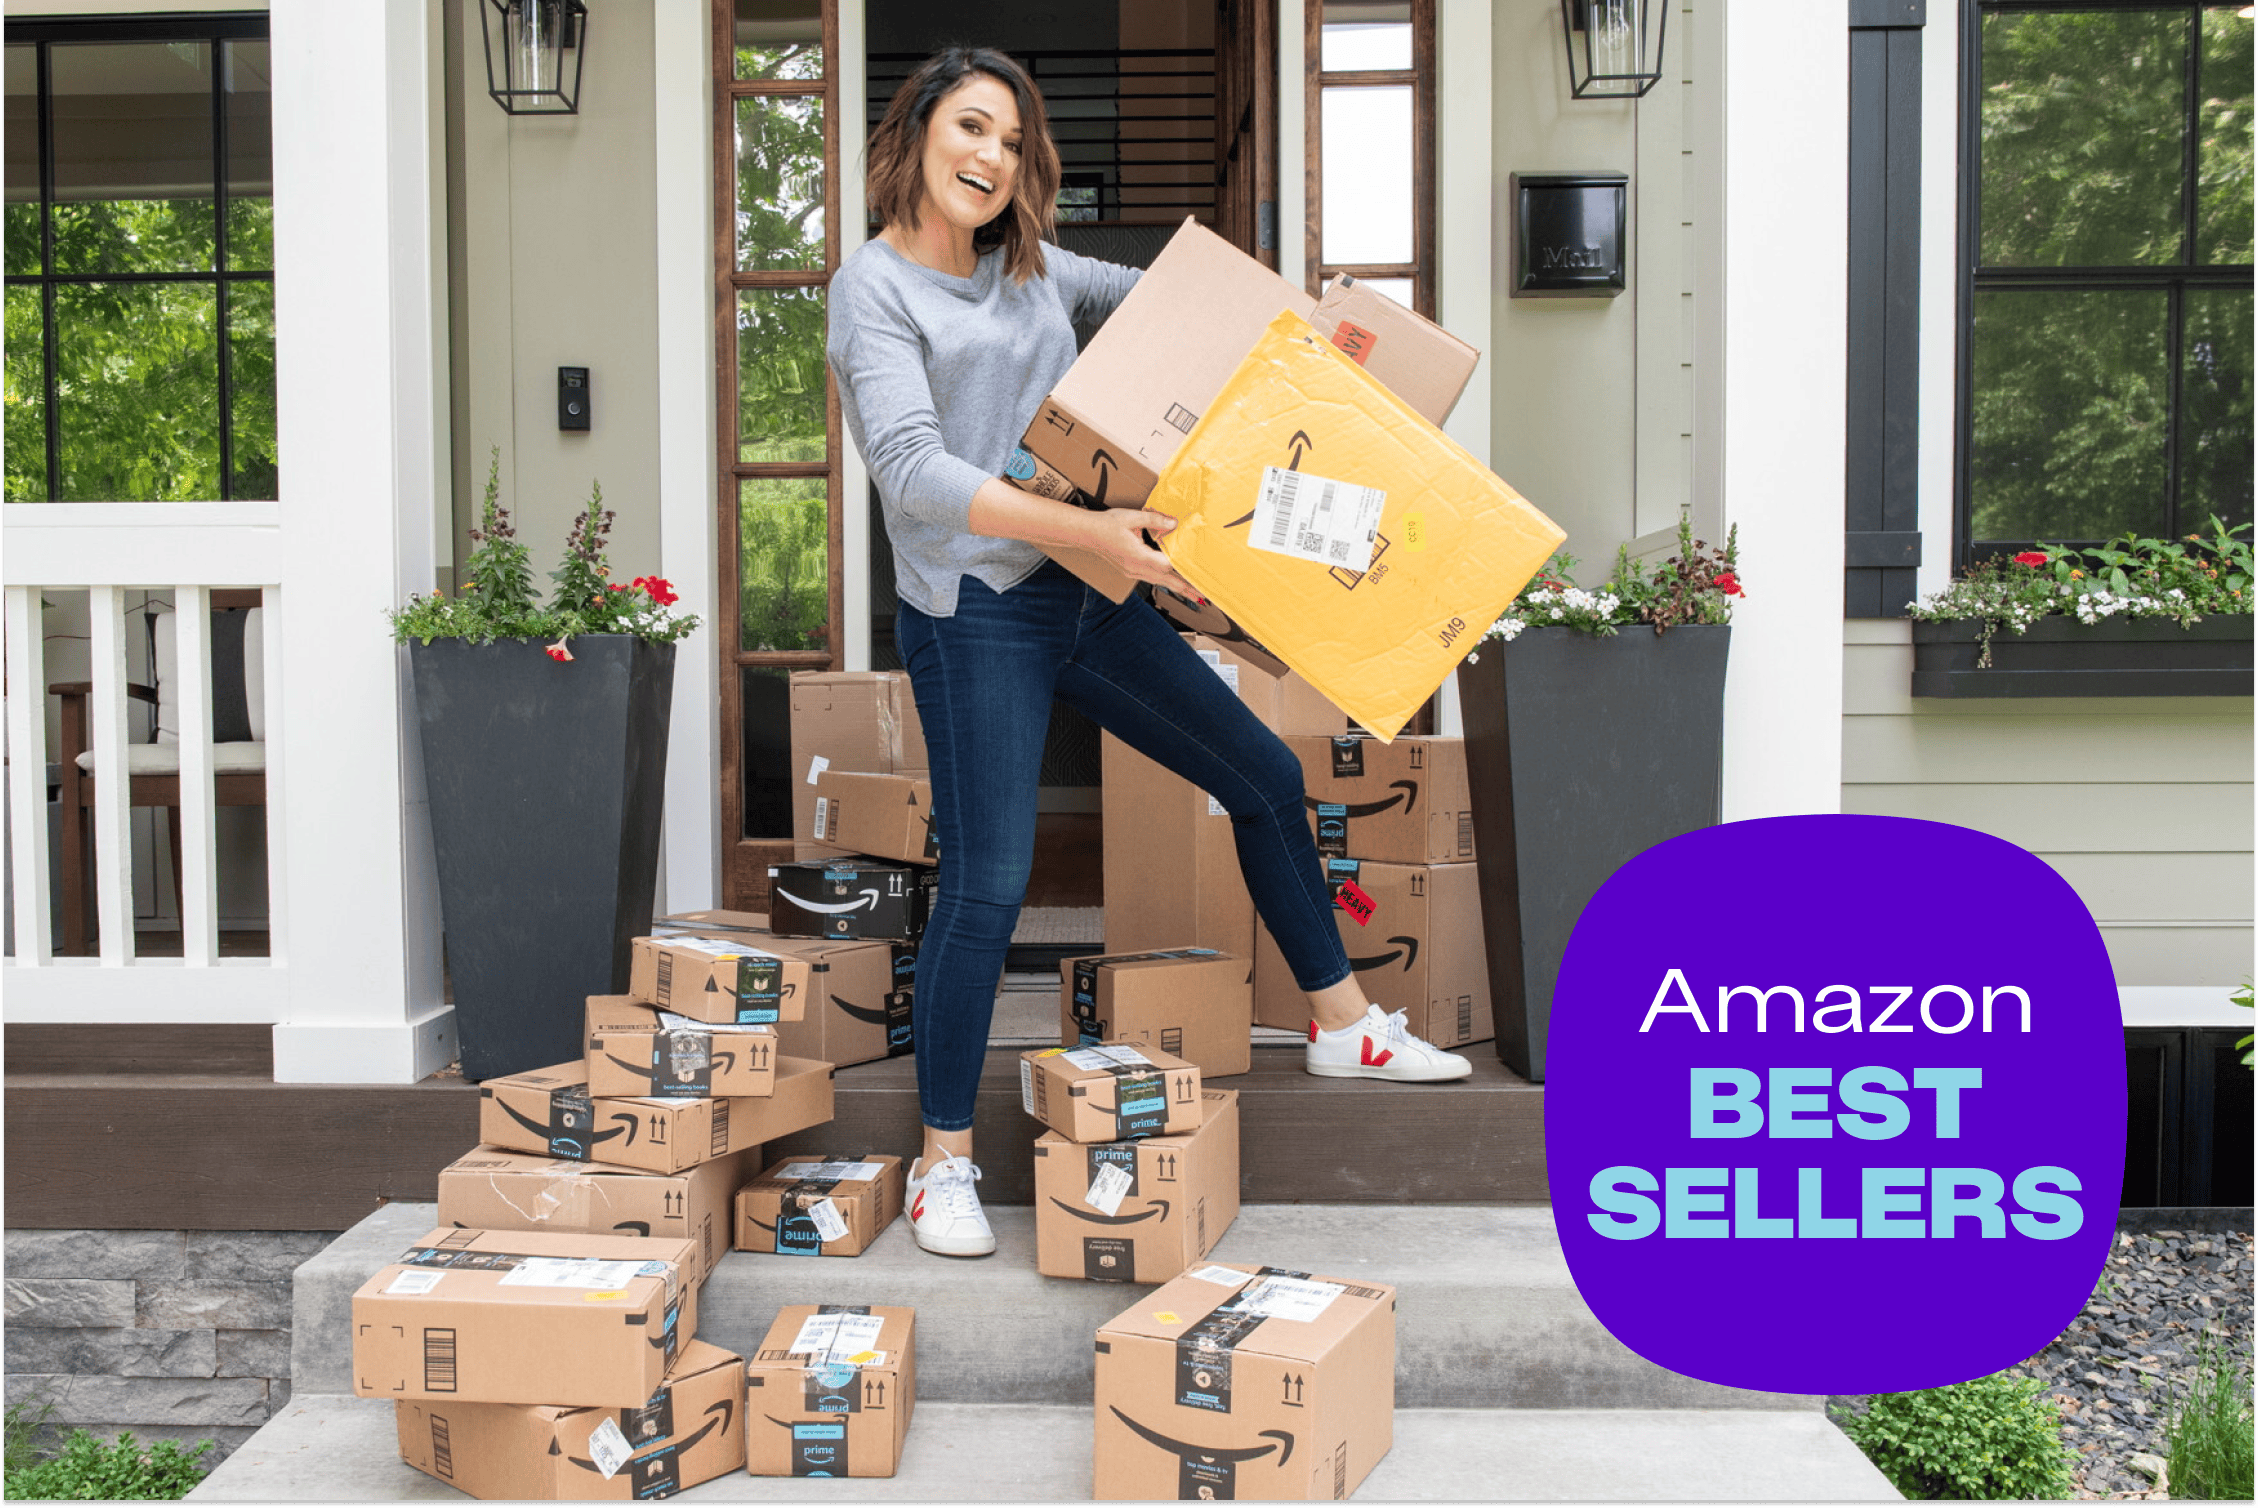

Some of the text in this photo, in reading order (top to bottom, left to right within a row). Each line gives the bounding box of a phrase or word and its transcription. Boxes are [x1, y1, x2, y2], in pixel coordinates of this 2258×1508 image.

[1542, 246, 1604, 269] Mail
[1368, 562, 1389, 585] BM5
[1438, 616, 1467, 649] JM9
[1340, 886, 1373, 919] HEAVY
[1094, 1148, 1133, 1162] prime
[819, 1402, 849, 1413] prime
[803, 1444, 835, 1457] prime
